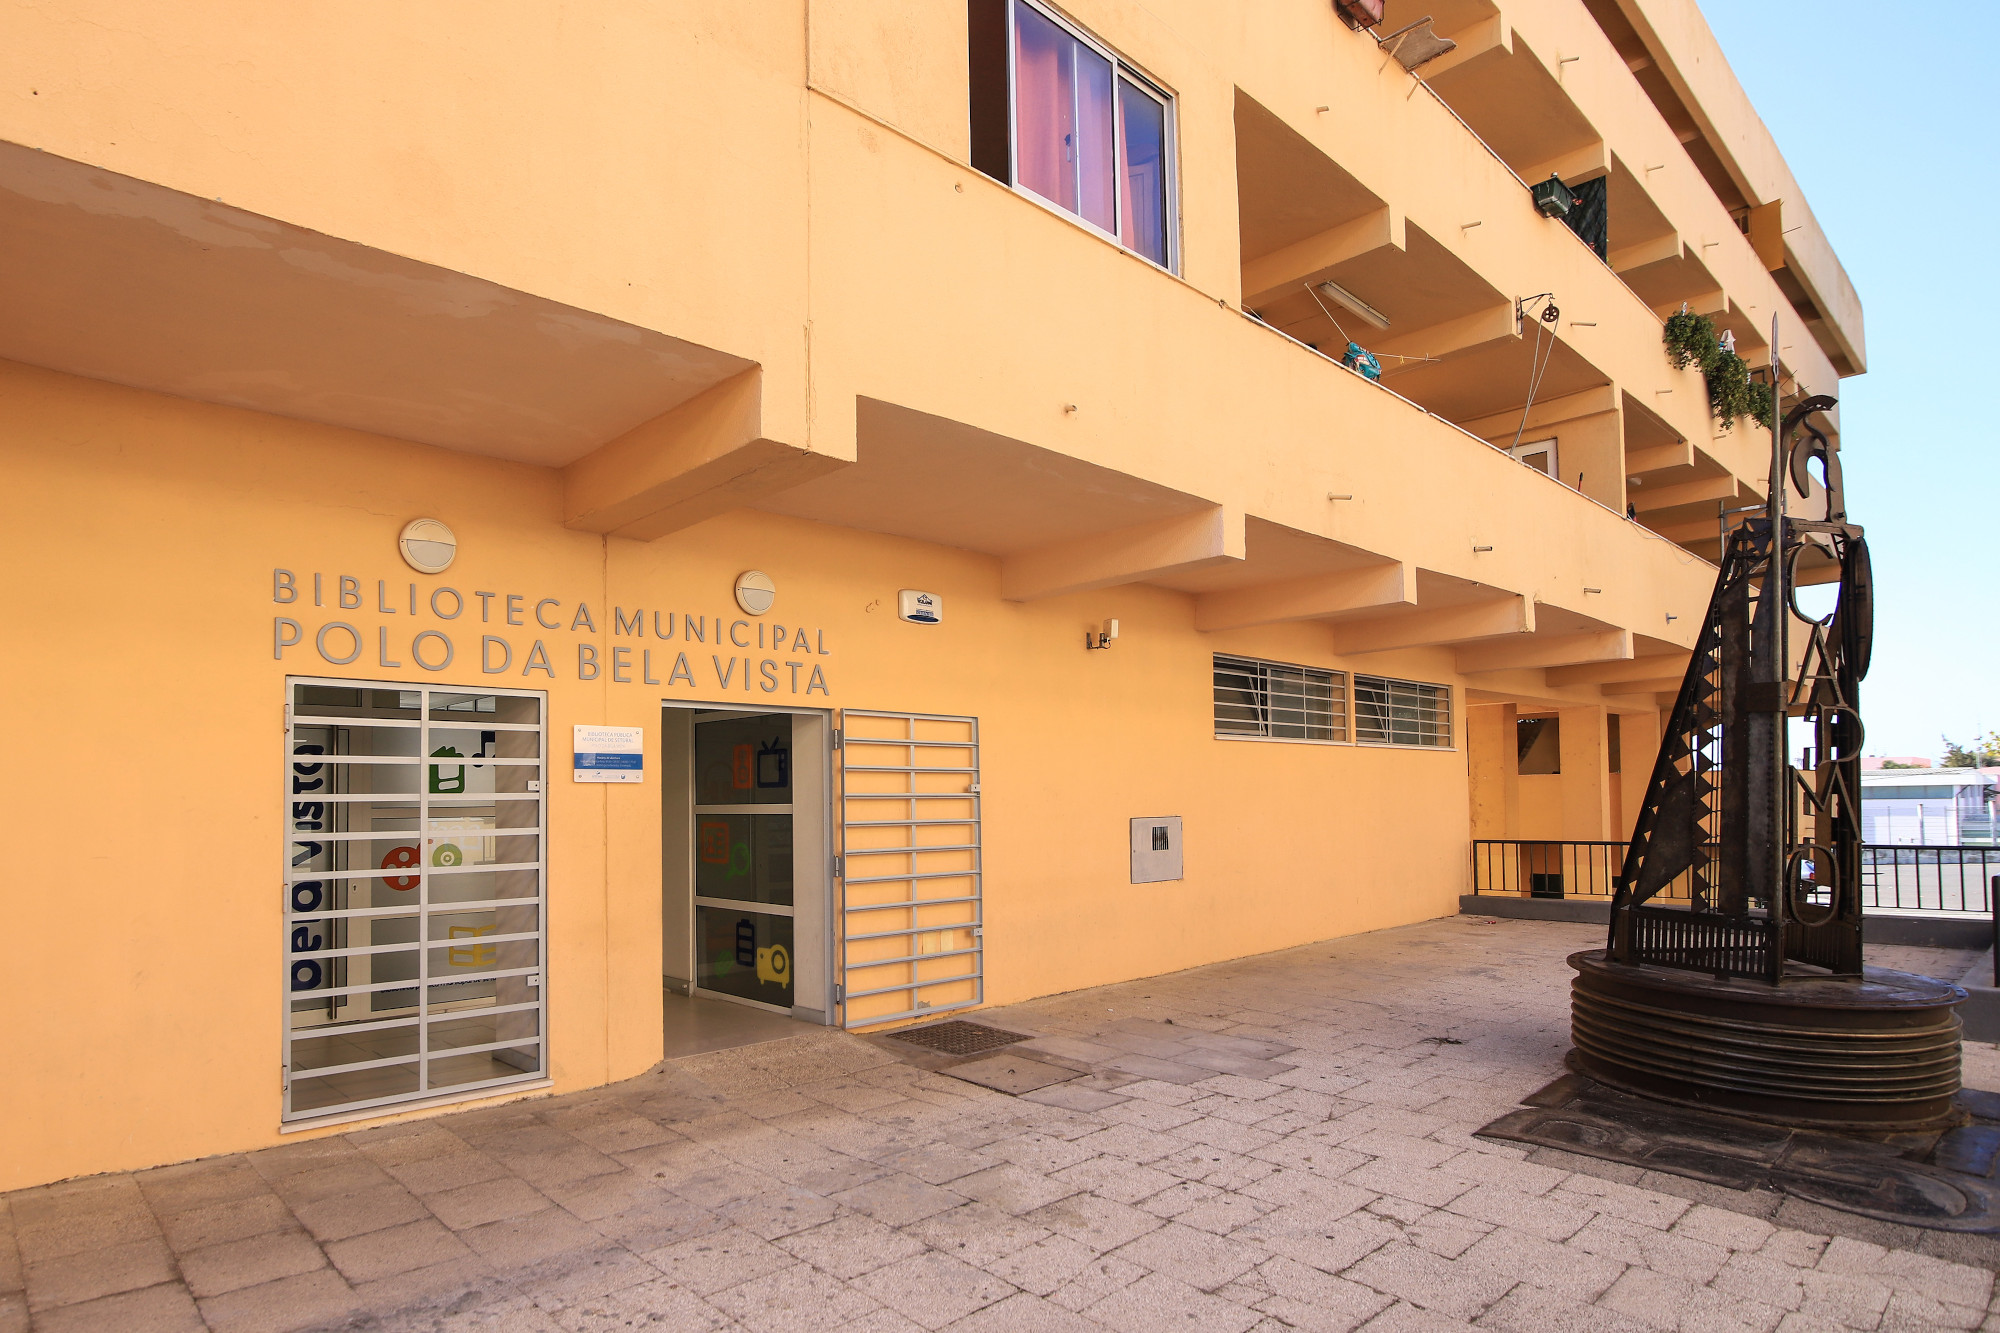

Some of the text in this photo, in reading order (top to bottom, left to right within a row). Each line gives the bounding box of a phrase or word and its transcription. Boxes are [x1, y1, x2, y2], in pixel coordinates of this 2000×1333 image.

[273, 567, 831, 656] BIBLIOTECA MUNICIPAL
[273, 616, 830, 696] POLO DA BELA VISTA
